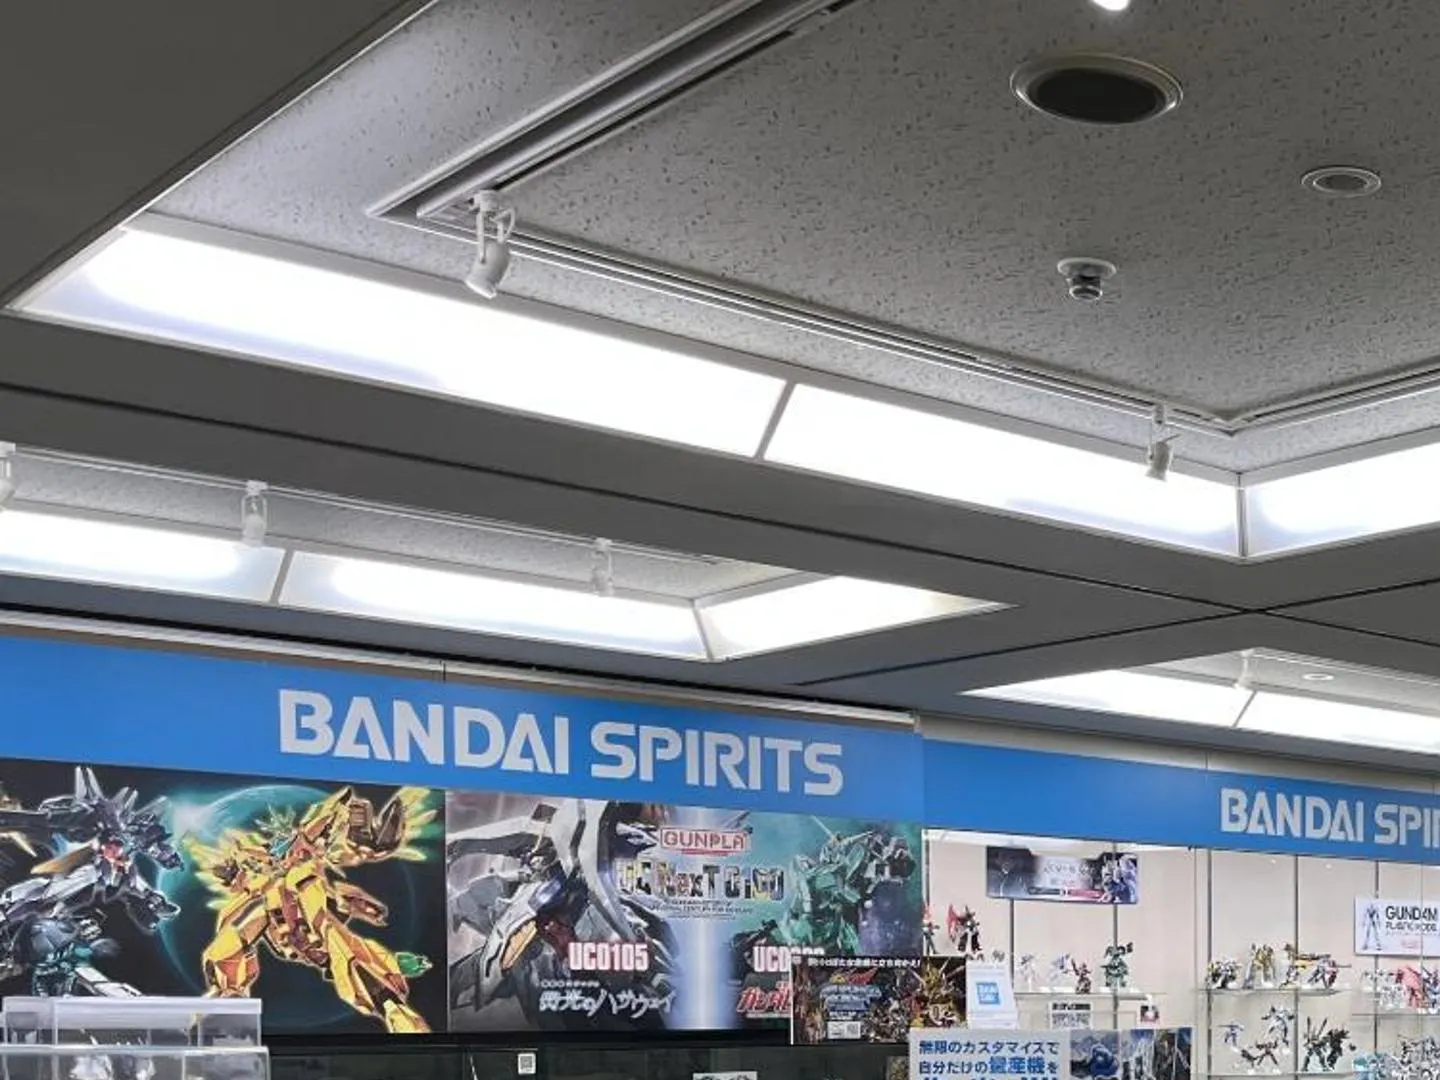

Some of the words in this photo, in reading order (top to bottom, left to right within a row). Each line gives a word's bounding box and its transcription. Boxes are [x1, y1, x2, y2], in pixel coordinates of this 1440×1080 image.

[279, 689, 568, 776] BANDAI
[591, 722, 845, 796] SPIRITS
[1221, 787, 1363, 844] BANDAI
[663, 829, 746, 850] GUNPLA
[1385, 904, 1438, 921] GUNDAM
[568, 941, 650, 972] UC0105
[919, 1056, 1057, 1075] 自分だけの量産機を
